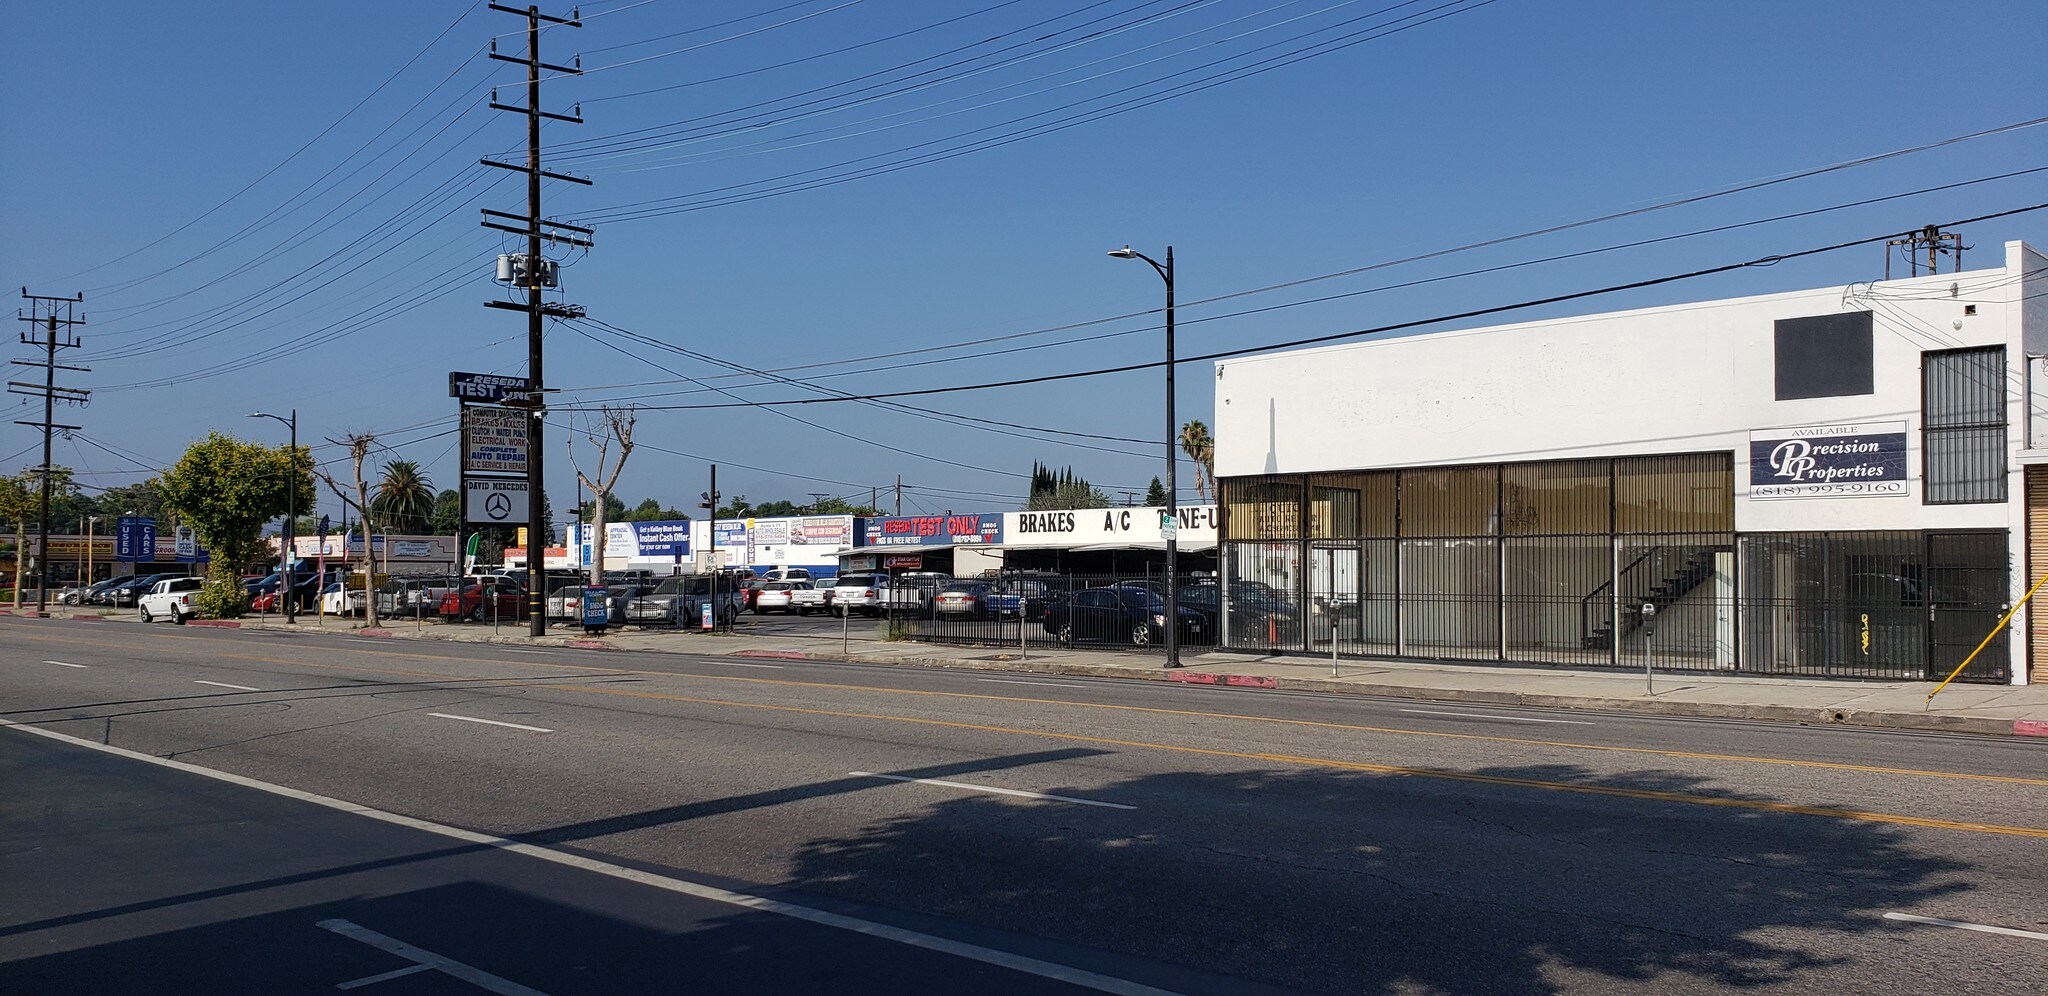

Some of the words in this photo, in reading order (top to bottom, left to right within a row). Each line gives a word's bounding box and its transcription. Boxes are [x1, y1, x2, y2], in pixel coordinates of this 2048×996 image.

[473, 376, 525, 387] RESEDA
[456, 381, 496, 398] TEST
[471, 417, 499, 427] BRAKES
[471, 427, 490, 436] CLUTCH
[496, 429, 511, 437] WATER
[1792, 427, 1858, 437] AVAILABLE
[472, 436, 505, 445] ELECTRICAL
[508, 438, 526, 447] WORK
[471, 452, 492, 460] AUTO
[496, 453, 526, 461] REPAIR
[1770, 439, 1879, 477] Precision
[482, 461, 502, 469] SERVICE
[509, 462, 526, 470] REPAIR
[1790, 456, 1884, 483] Properties
[468, 481, 490, 490] DAVID
[492, 482, 528, 491] MERCEDES
[1755, 485, 1801, 496] (818)
[1808, 482, 1901, 494] 995-9160
[911, 516, 945, 537] TEST
[947, 515, 980, 536] ONLY
[1019, 512, 1075, 533] BRAKES
[1104, 510, 1131, 534] A/C
[122, 526, 130, 554] USED
[143, 526, 151, 554] CARS
[640, 534, 658, 543] Instant
[659, 533, 673, 541] Cash
[893, 536, 905, 544] FREE
